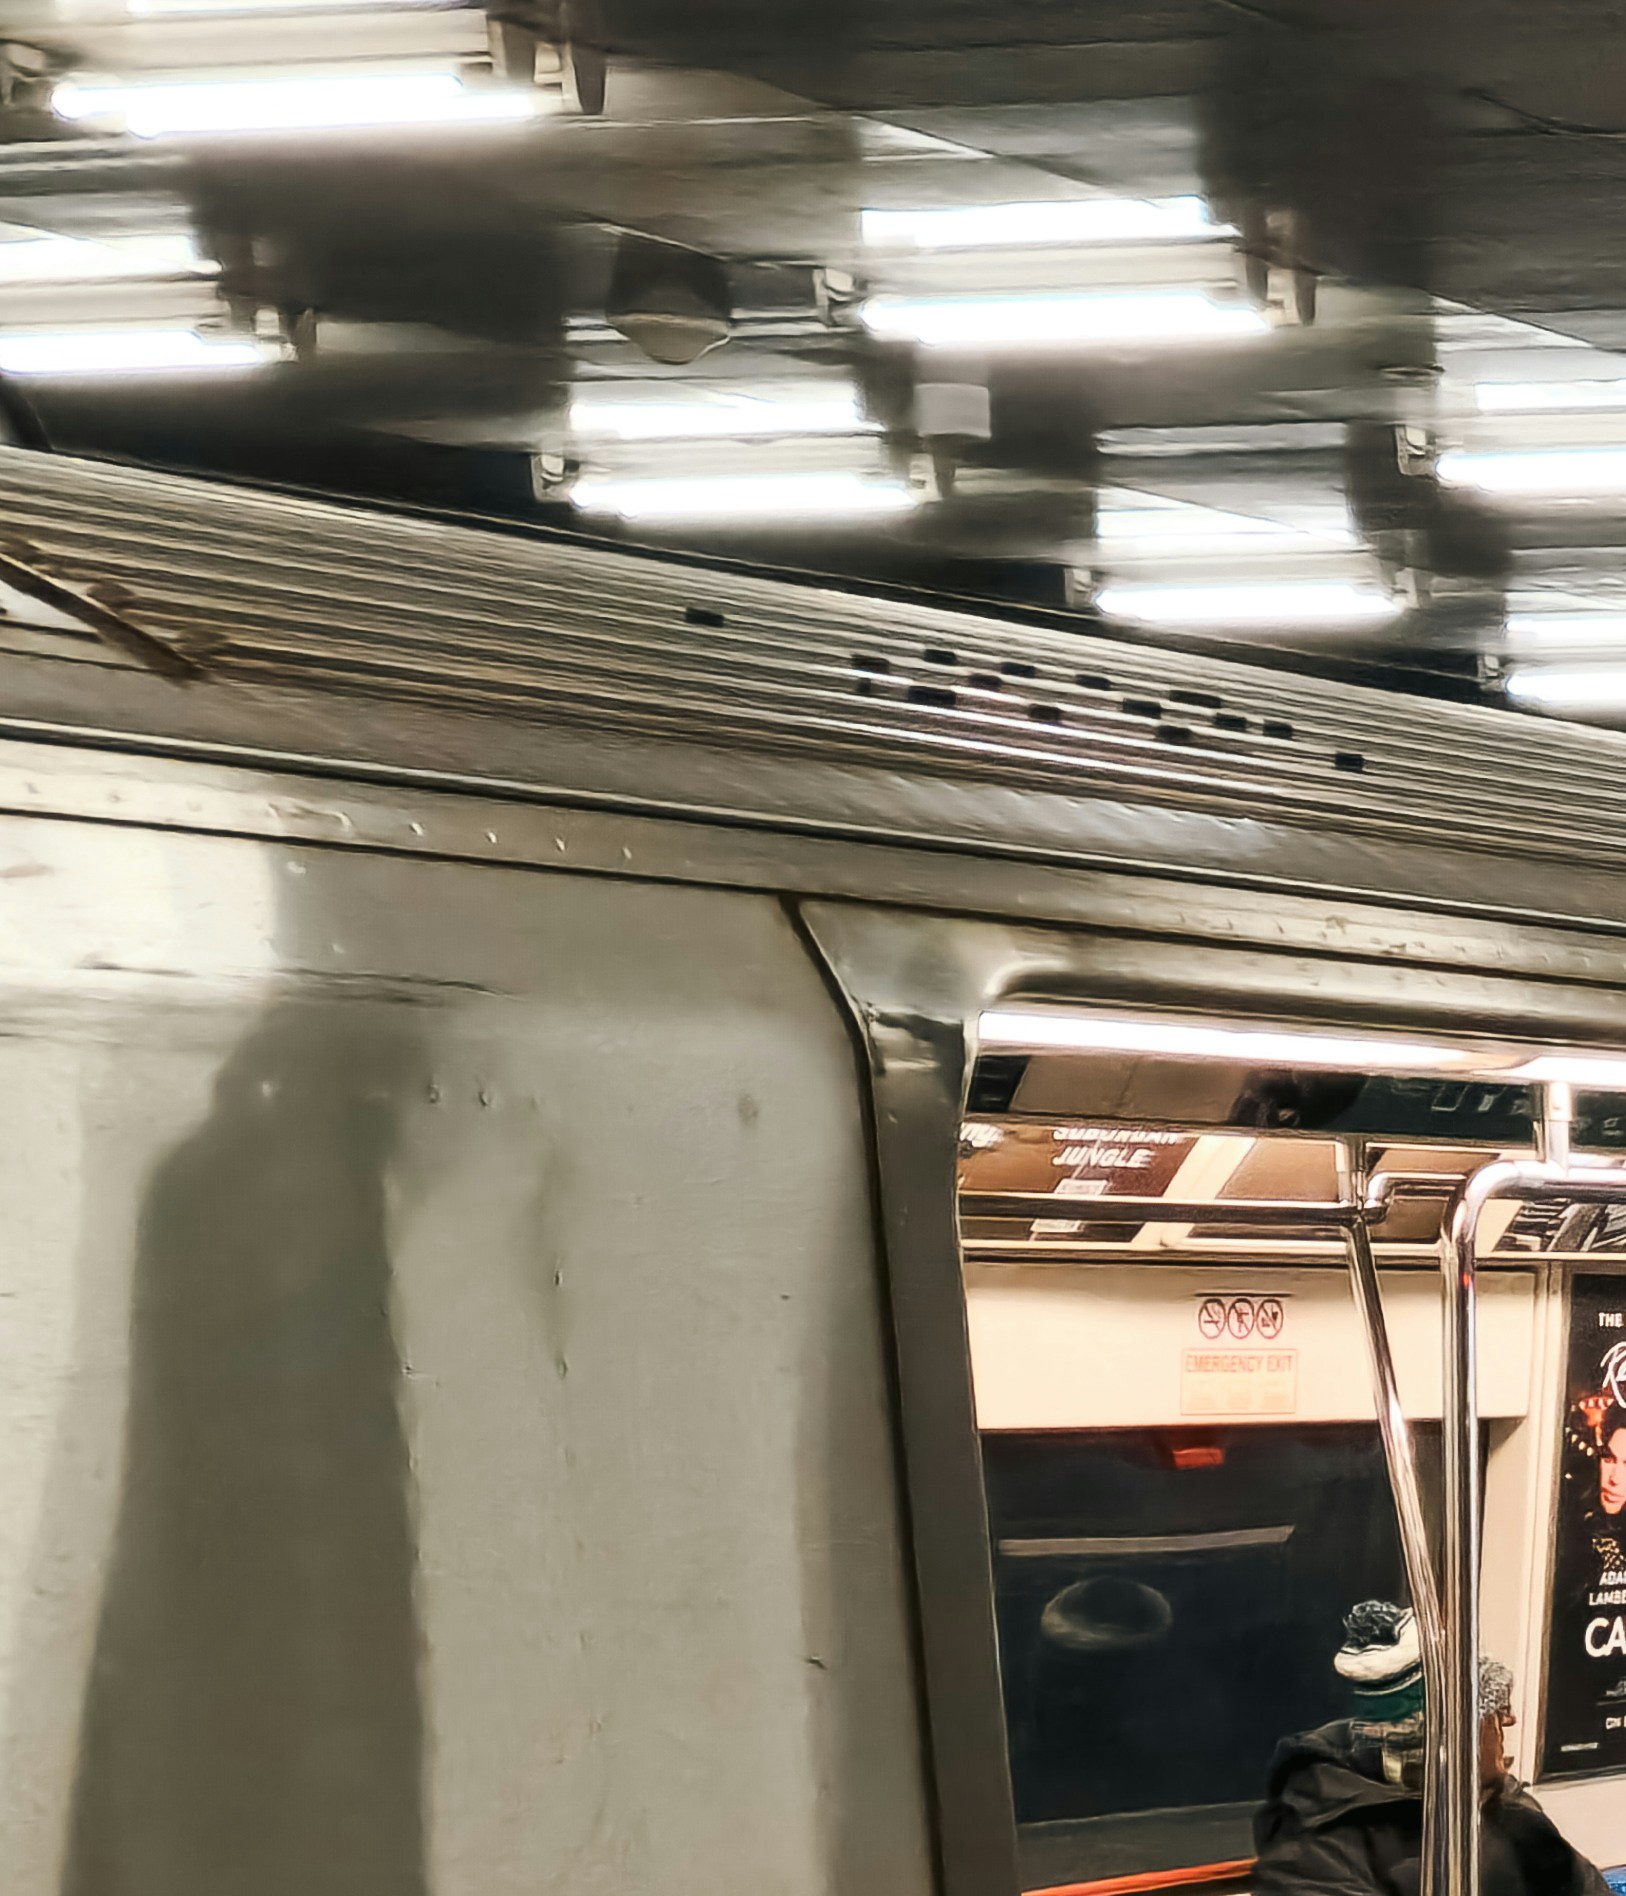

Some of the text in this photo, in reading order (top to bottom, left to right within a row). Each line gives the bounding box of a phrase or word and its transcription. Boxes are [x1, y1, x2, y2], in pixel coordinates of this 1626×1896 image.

[1052, 1146, 1154, 1168] JUNGLE
[1598, 1312, 1624, 1328] THE
[1184, 1355, 1293, 1373] EMERGENCY EXIT
